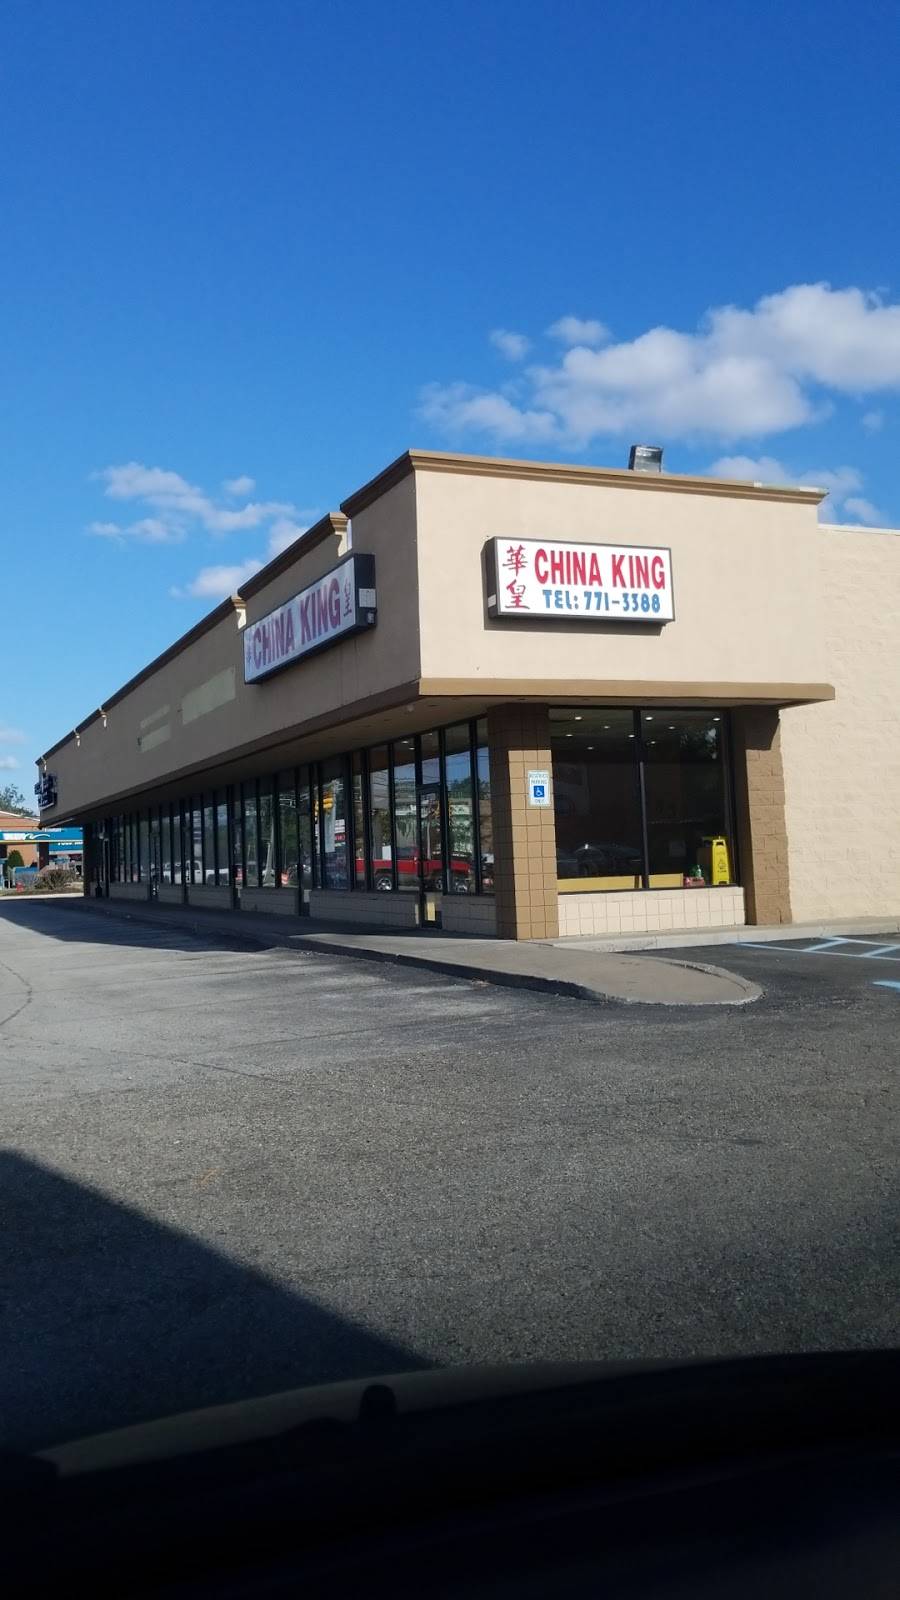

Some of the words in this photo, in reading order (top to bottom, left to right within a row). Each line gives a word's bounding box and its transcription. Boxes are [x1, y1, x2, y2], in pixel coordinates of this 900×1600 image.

[534, 548, 603, 587] CHINA
[611, 553, 666, 590] KING
[542, 589, 579, 610] TEL:
[584, 590, 661, 614] 771-3388
[252, 608, 296, 670] CHINA
[299, 578, 341, 645] KING
